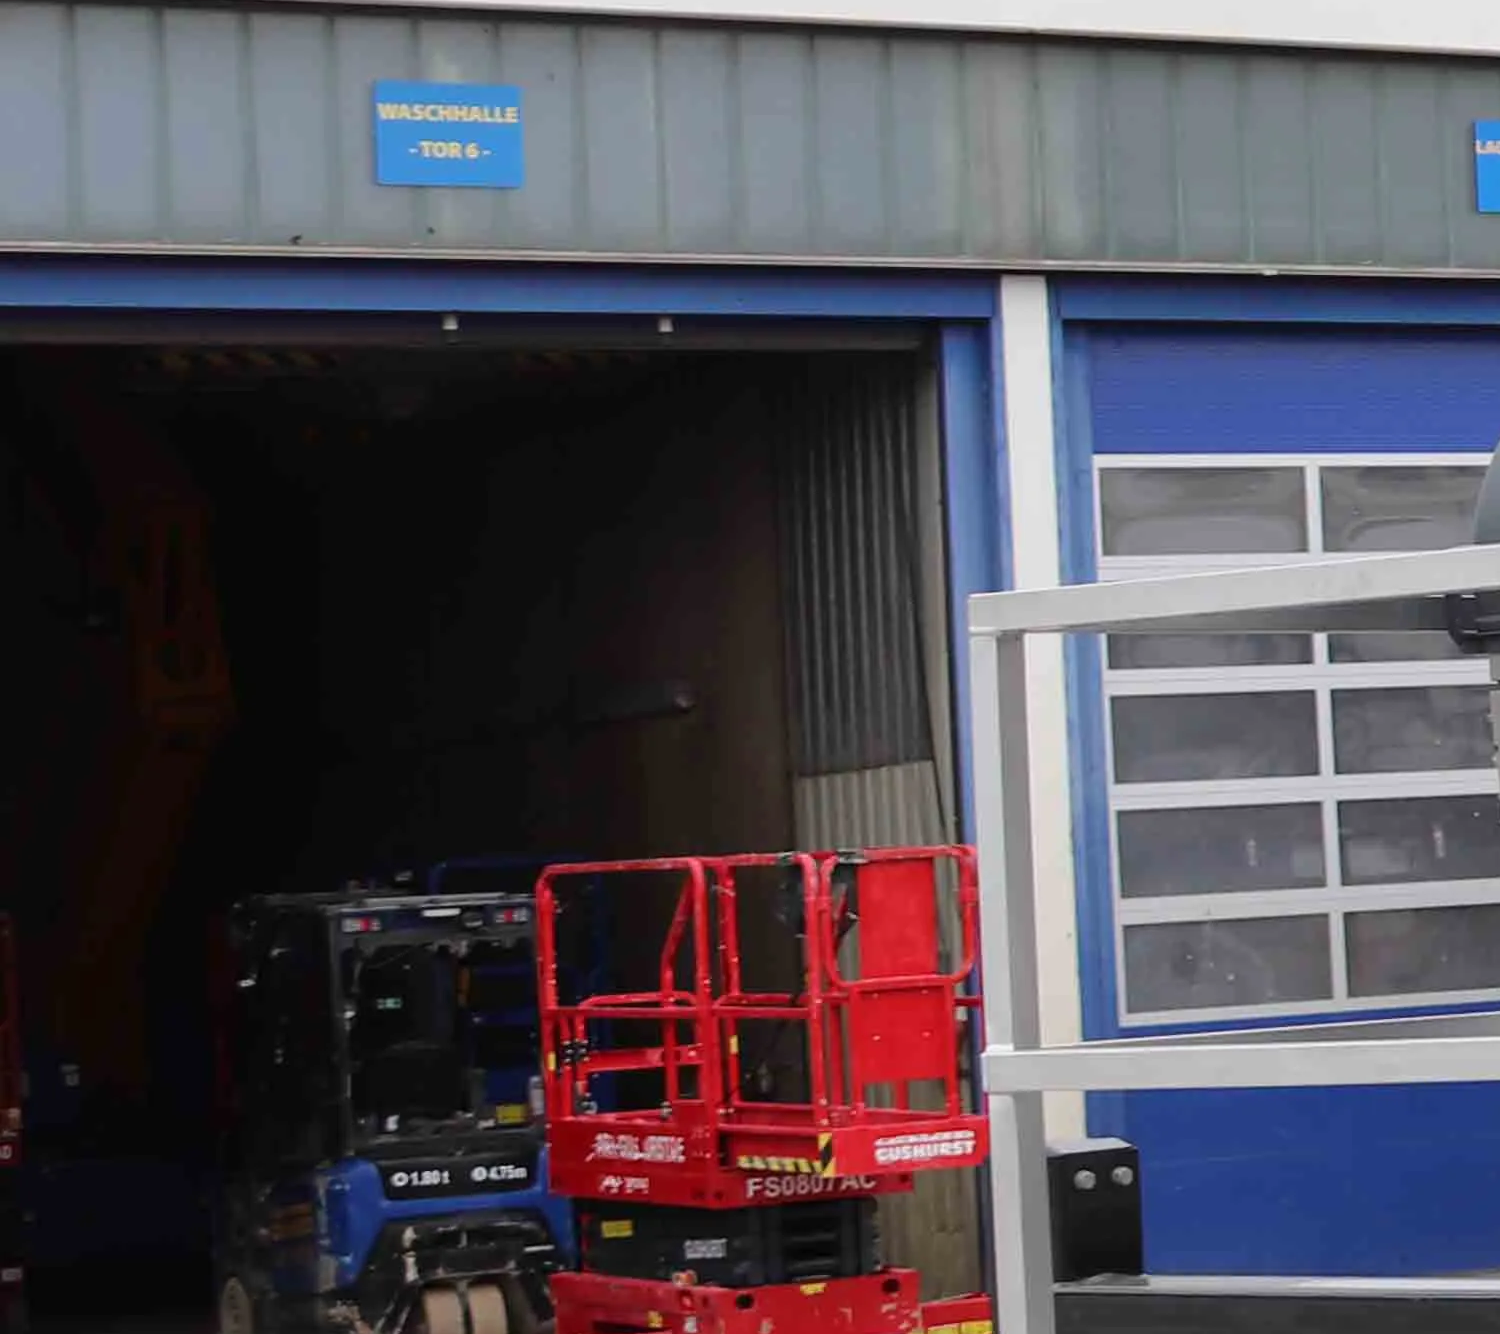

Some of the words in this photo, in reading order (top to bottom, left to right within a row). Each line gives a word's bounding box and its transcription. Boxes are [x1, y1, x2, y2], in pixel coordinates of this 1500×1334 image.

[376, 102, 519, 123] WASCHHALLE
[419, 139, 463, 158] TOR
[464, 142, 480, 159] 6
[874, 1139, 977, 1165] GUSHURST
